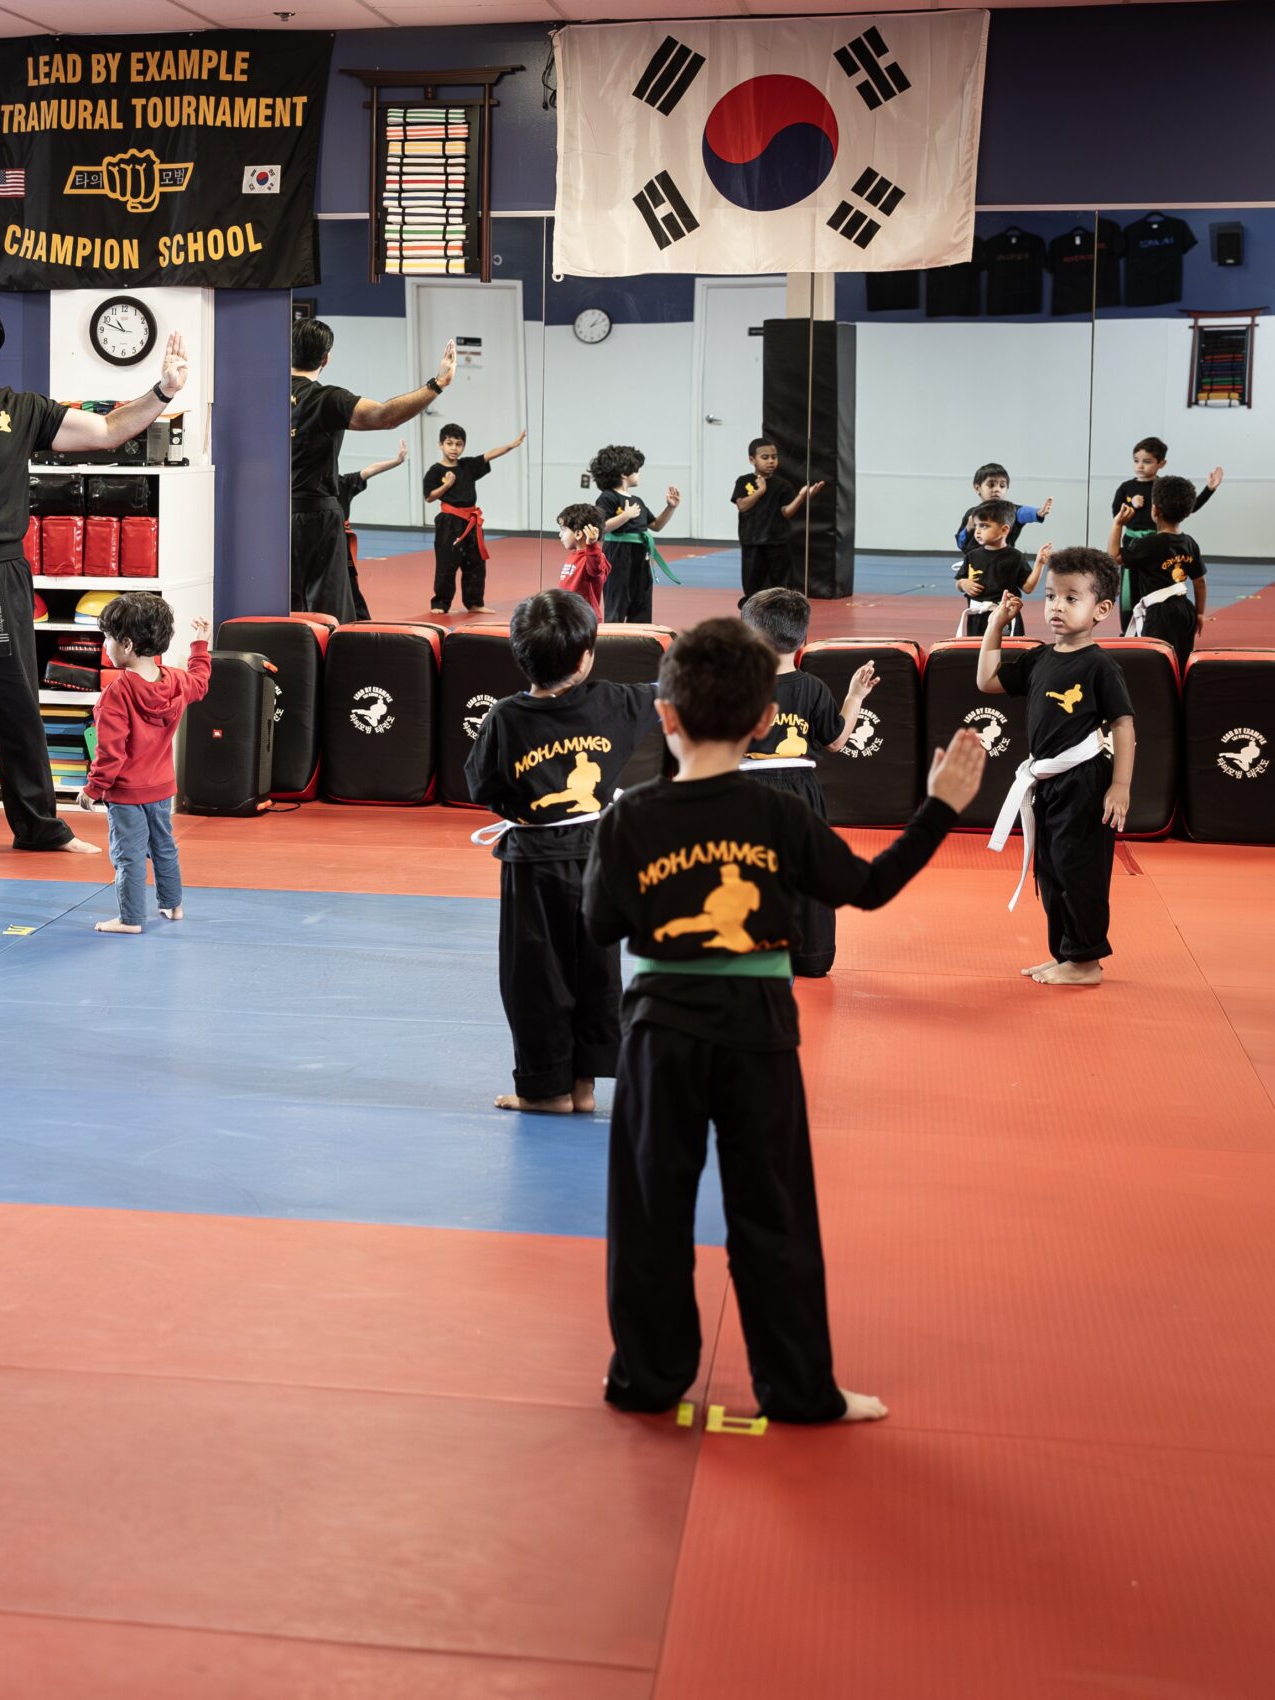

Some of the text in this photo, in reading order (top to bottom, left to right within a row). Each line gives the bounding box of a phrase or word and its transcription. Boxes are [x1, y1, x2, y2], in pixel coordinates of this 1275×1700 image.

[27, 49, 250, 87] LEAD BY EXAMPLE
[131, 95, 308, 129] TOURNAMENT
[75, 169, 186, 189] 타의 모범
[4, 222, 263, 270] CHAMPION SCHOOL
[514, 735, 613, 779] MOHAMMED
